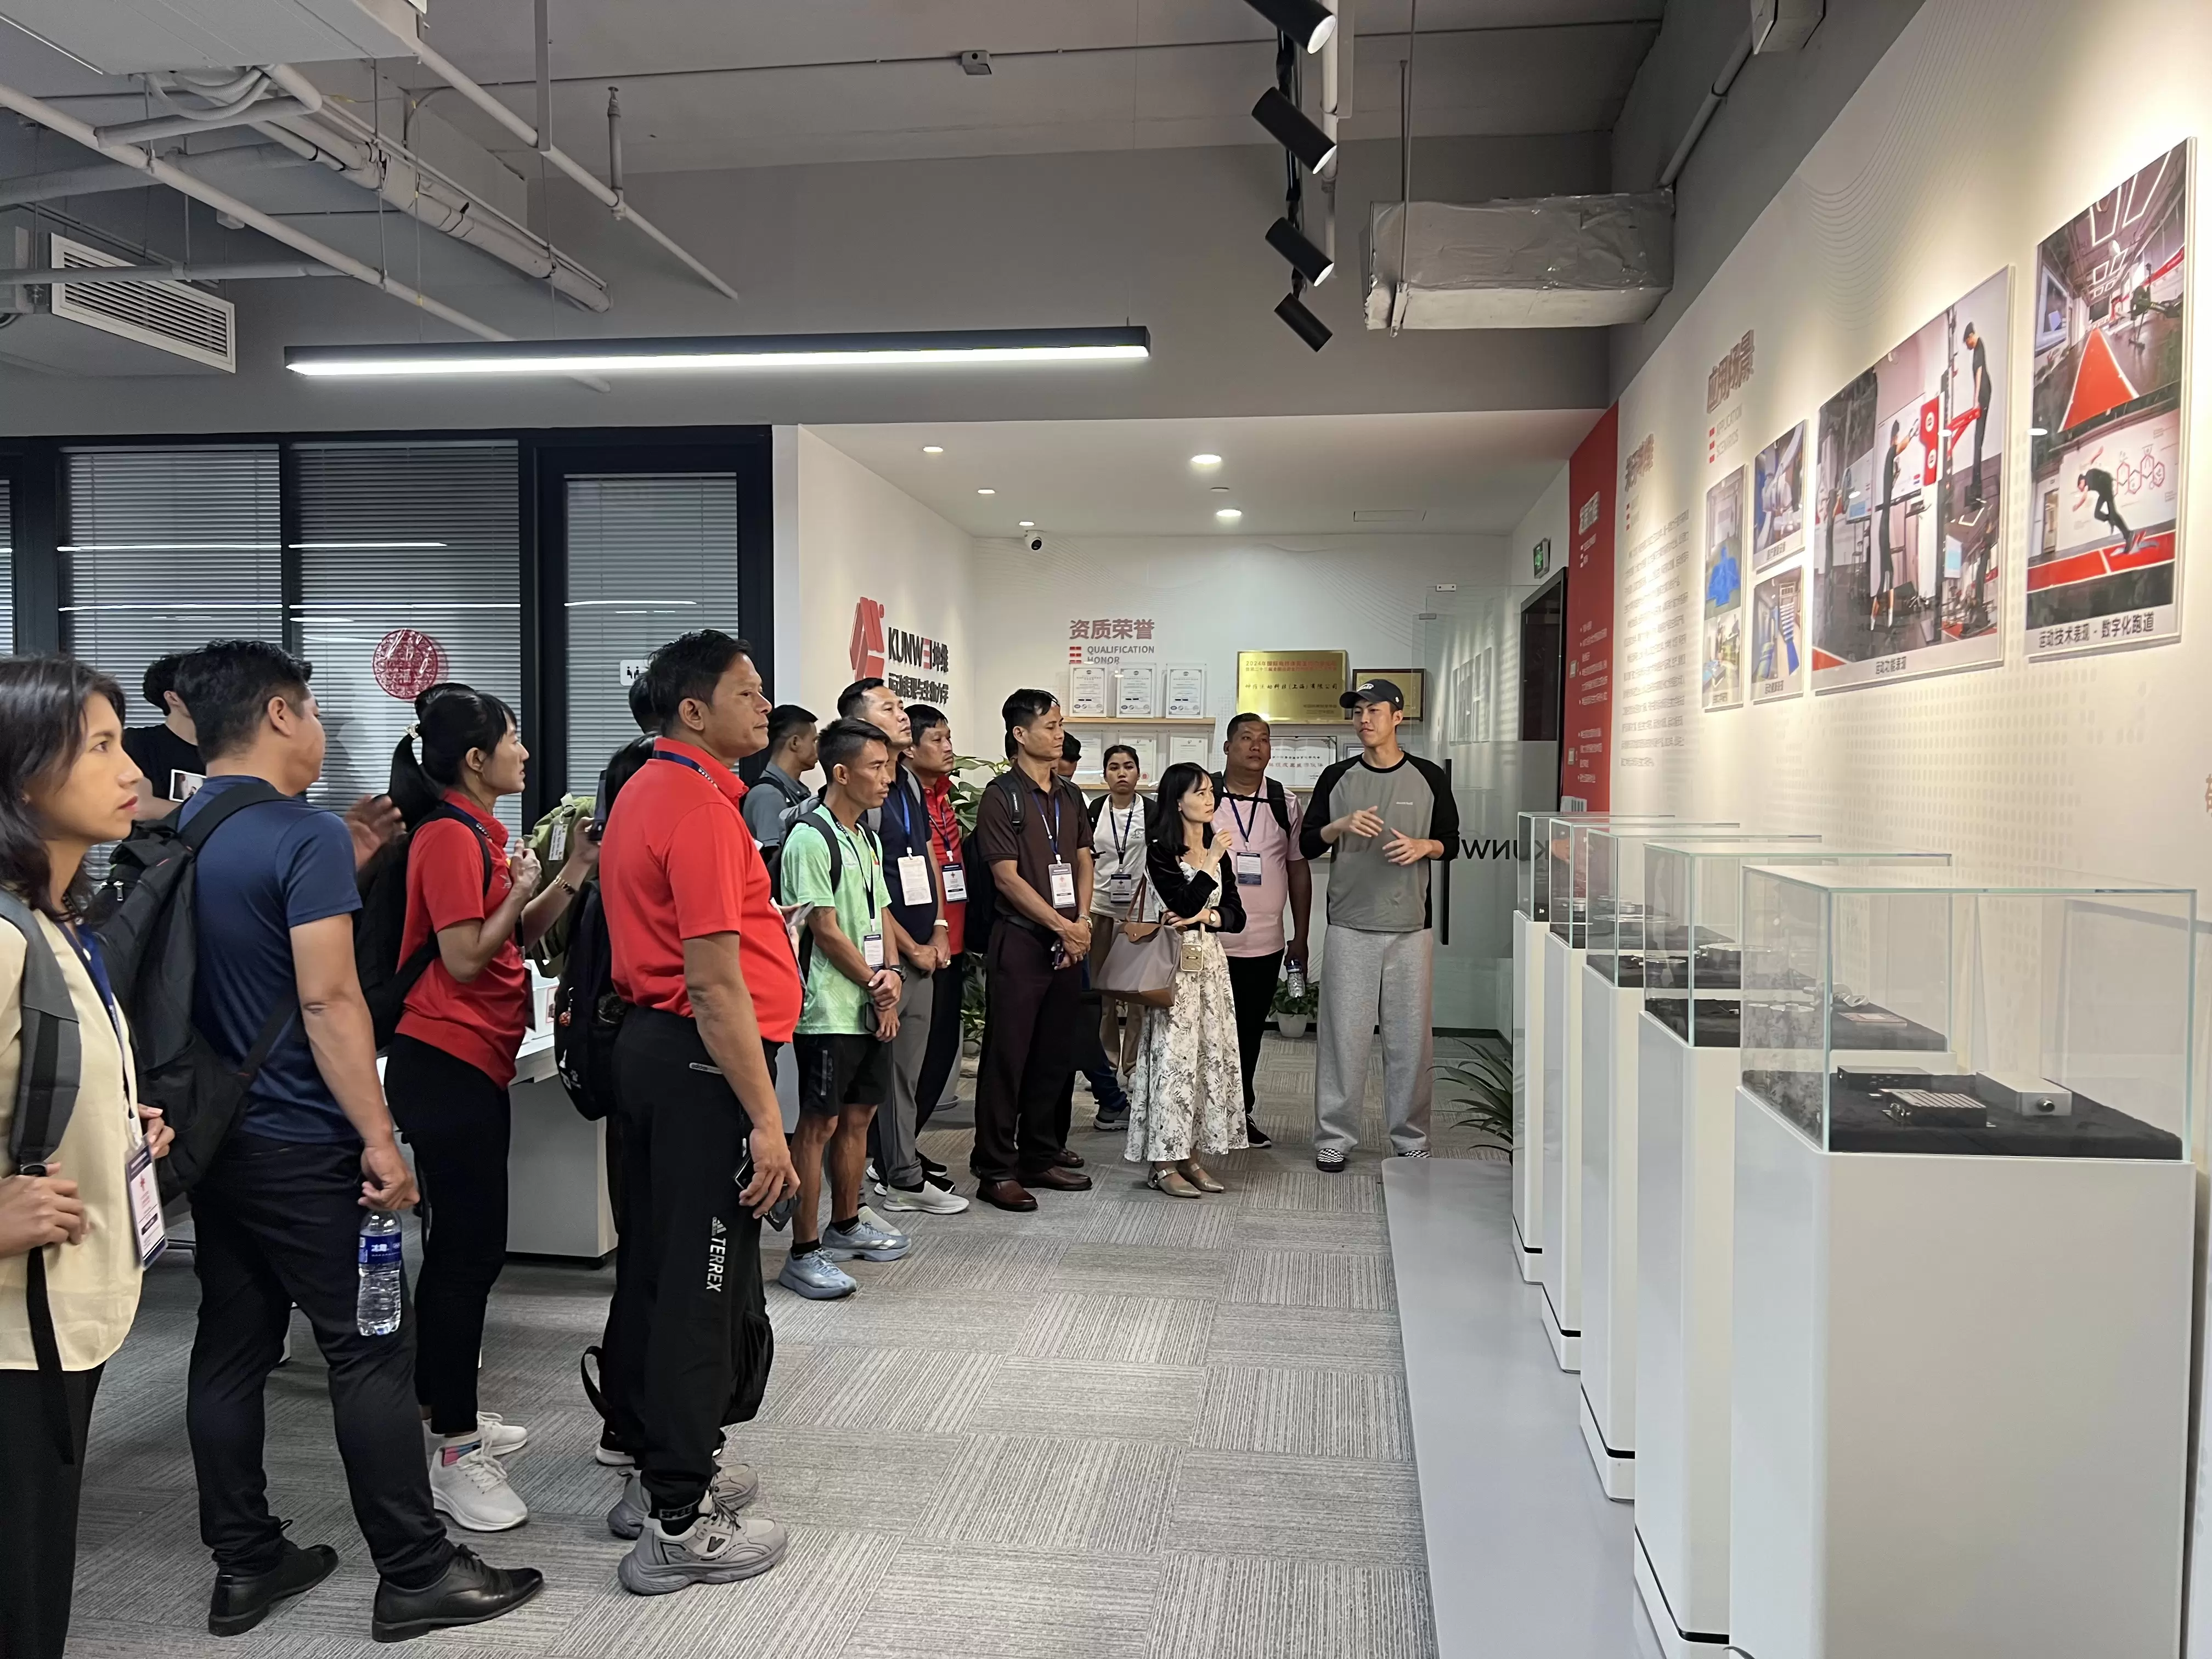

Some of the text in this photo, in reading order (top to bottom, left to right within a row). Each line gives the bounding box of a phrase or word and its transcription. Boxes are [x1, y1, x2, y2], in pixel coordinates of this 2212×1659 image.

[1069, 619, 1155, 640] 资质荣誉
[2039, 623, 2090, 648] 运动技术表现
[2101, 611, 2155, 639] 数字化跑道
[888, 627, 933, 670] KUNWEI
[1087, 645, 1154, 655] QUALIFICATION
[1087, 656, 1120, 664] HONOR
[706, 1238, 726, 1293] TERREX
